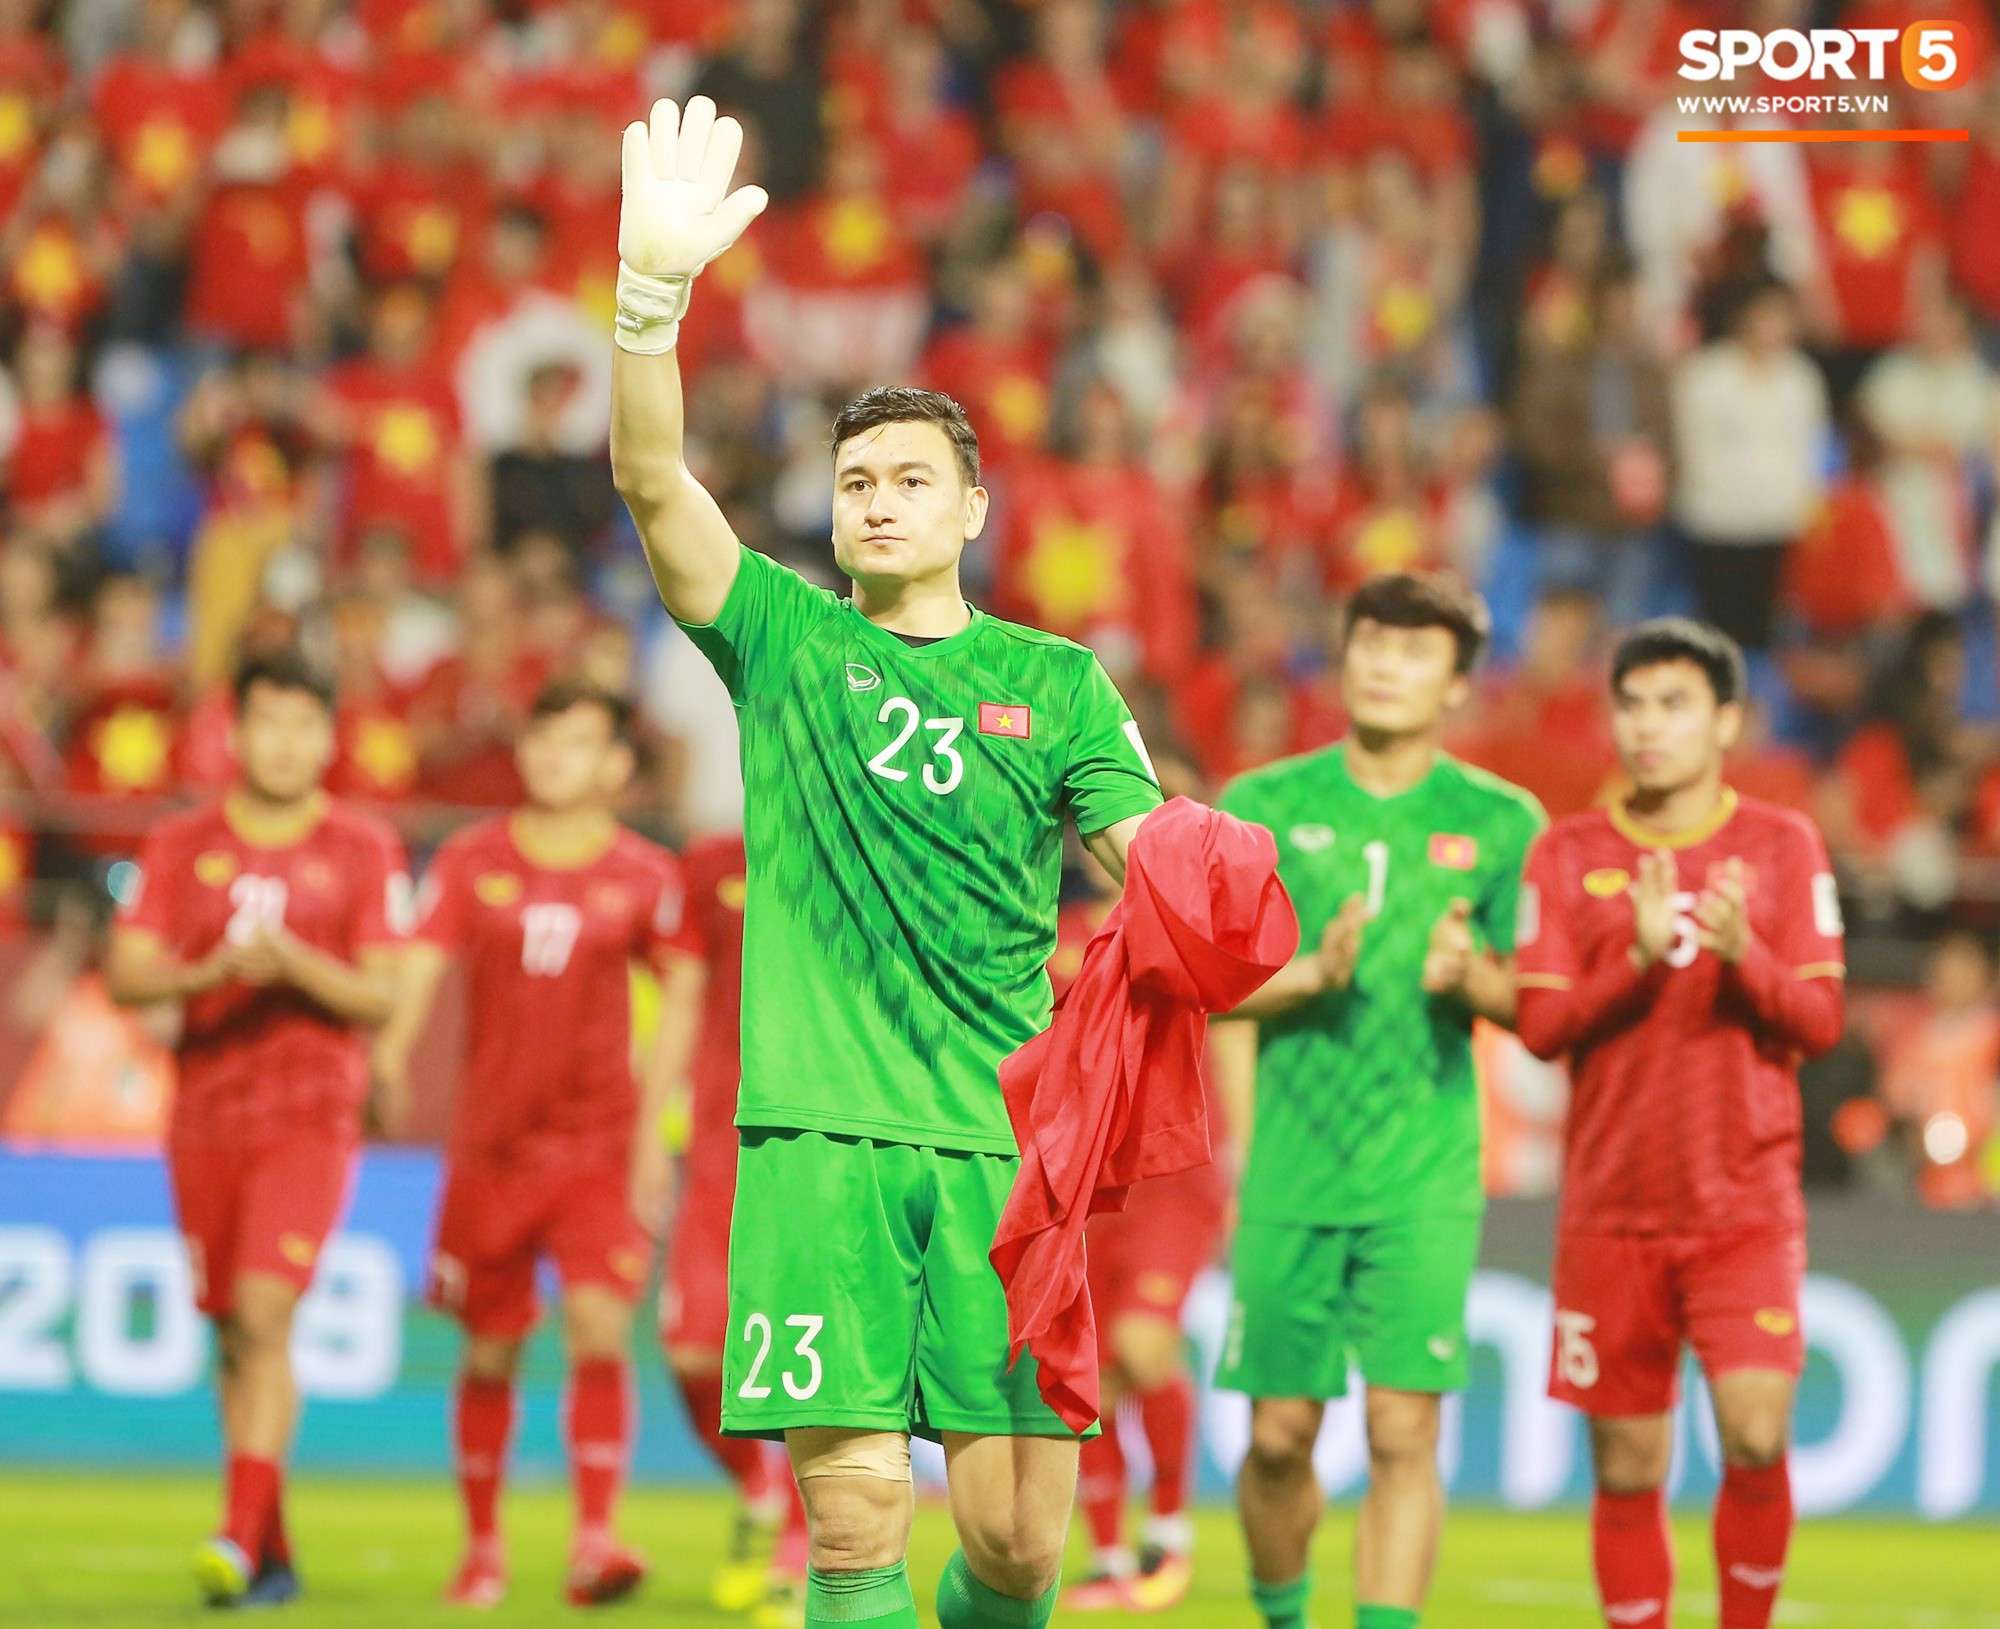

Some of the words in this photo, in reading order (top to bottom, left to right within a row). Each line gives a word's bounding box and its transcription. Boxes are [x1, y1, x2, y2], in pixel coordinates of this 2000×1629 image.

[867, 696, 965, 796] 23
[0, 1227, 402, 1400] 209
[738, 1312, 824, 1400] 23
